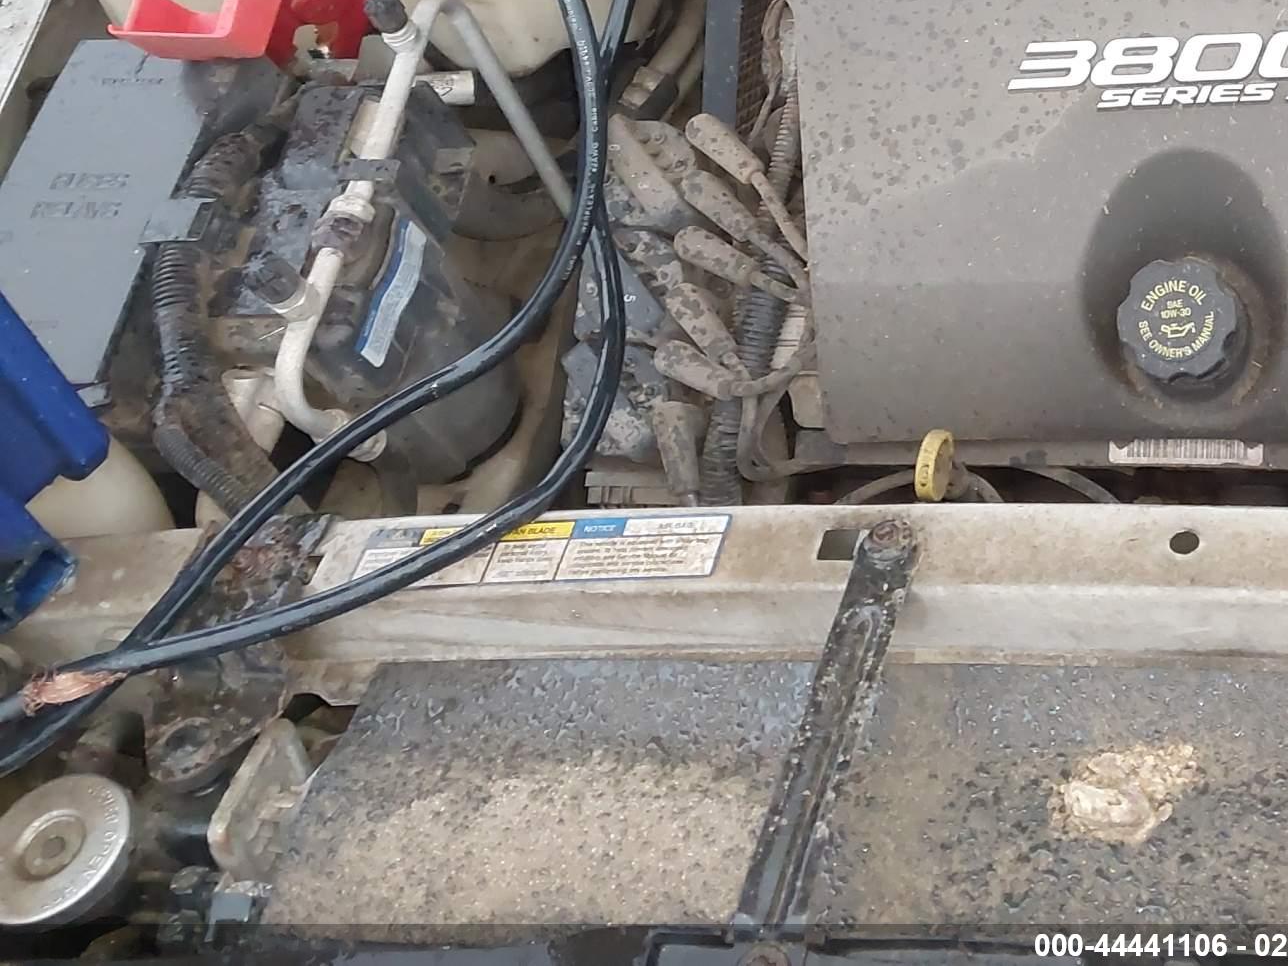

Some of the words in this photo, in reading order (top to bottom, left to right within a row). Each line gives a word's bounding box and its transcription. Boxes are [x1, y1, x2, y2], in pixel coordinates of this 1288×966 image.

[1096, 83, 1278, 109] SERIES
[1141, 280, 1187, 312] ENGINE
[1189, 285, 1207, 306] OIL
[1166, 299, 1184, 309] SAE
[1160, 307, 1192, 319] 10W-30
[1138, 320, 1153, 341] SEE
[1191, 311, 1215, 351] MANUAL
[583, 524, 617, 533] NOTICE
